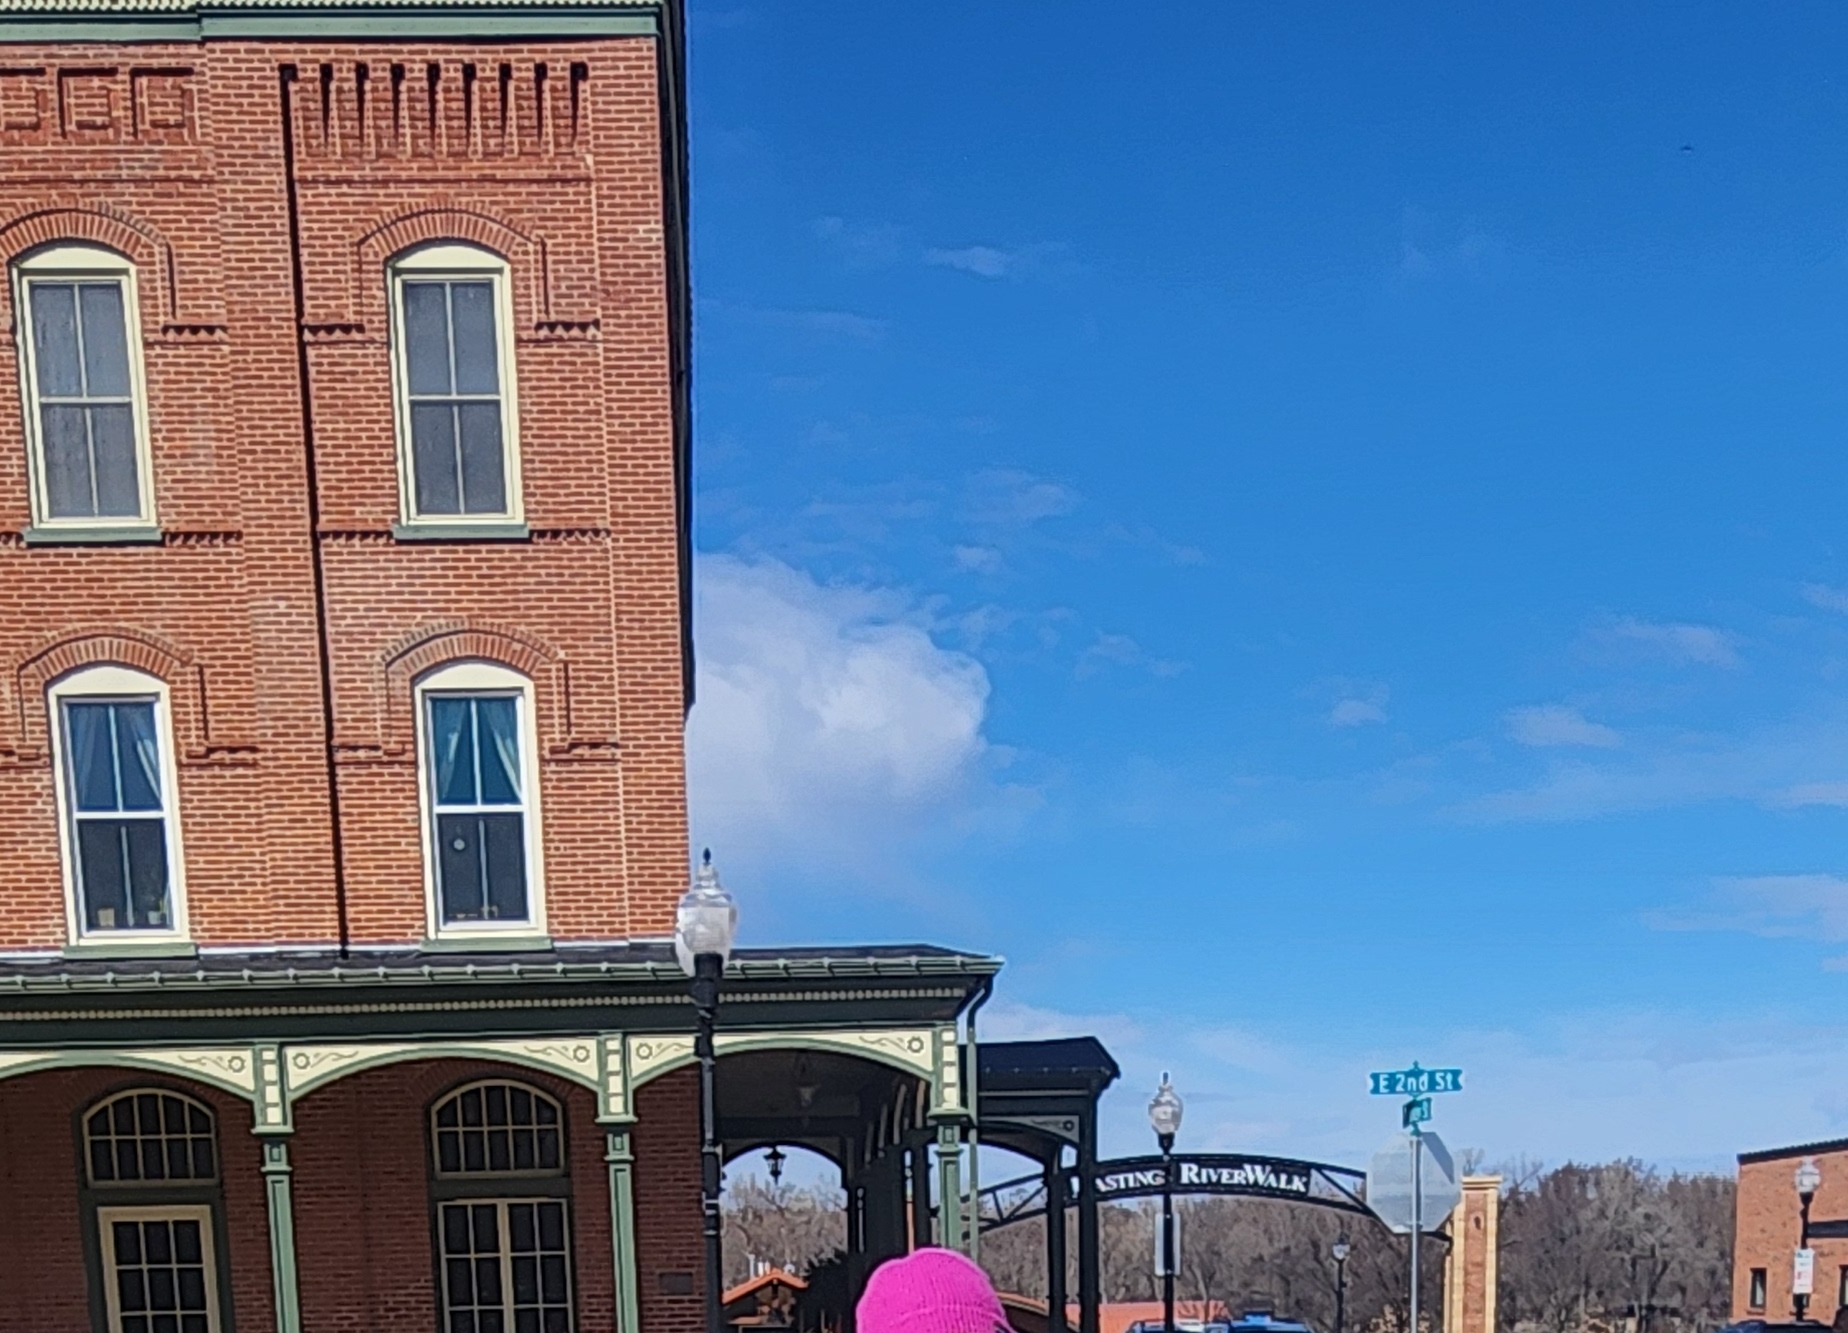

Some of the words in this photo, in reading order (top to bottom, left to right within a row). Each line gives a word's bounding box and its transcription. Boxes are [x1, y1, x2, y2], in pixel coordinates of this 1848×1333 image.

[1379, 1073, 1390, 1093] E
[1395, 1072, 1429, 1092] 2nd
[1435, 1072, 1453, 1090] St
[1070, 1169, 1173, 1198] ASTING
